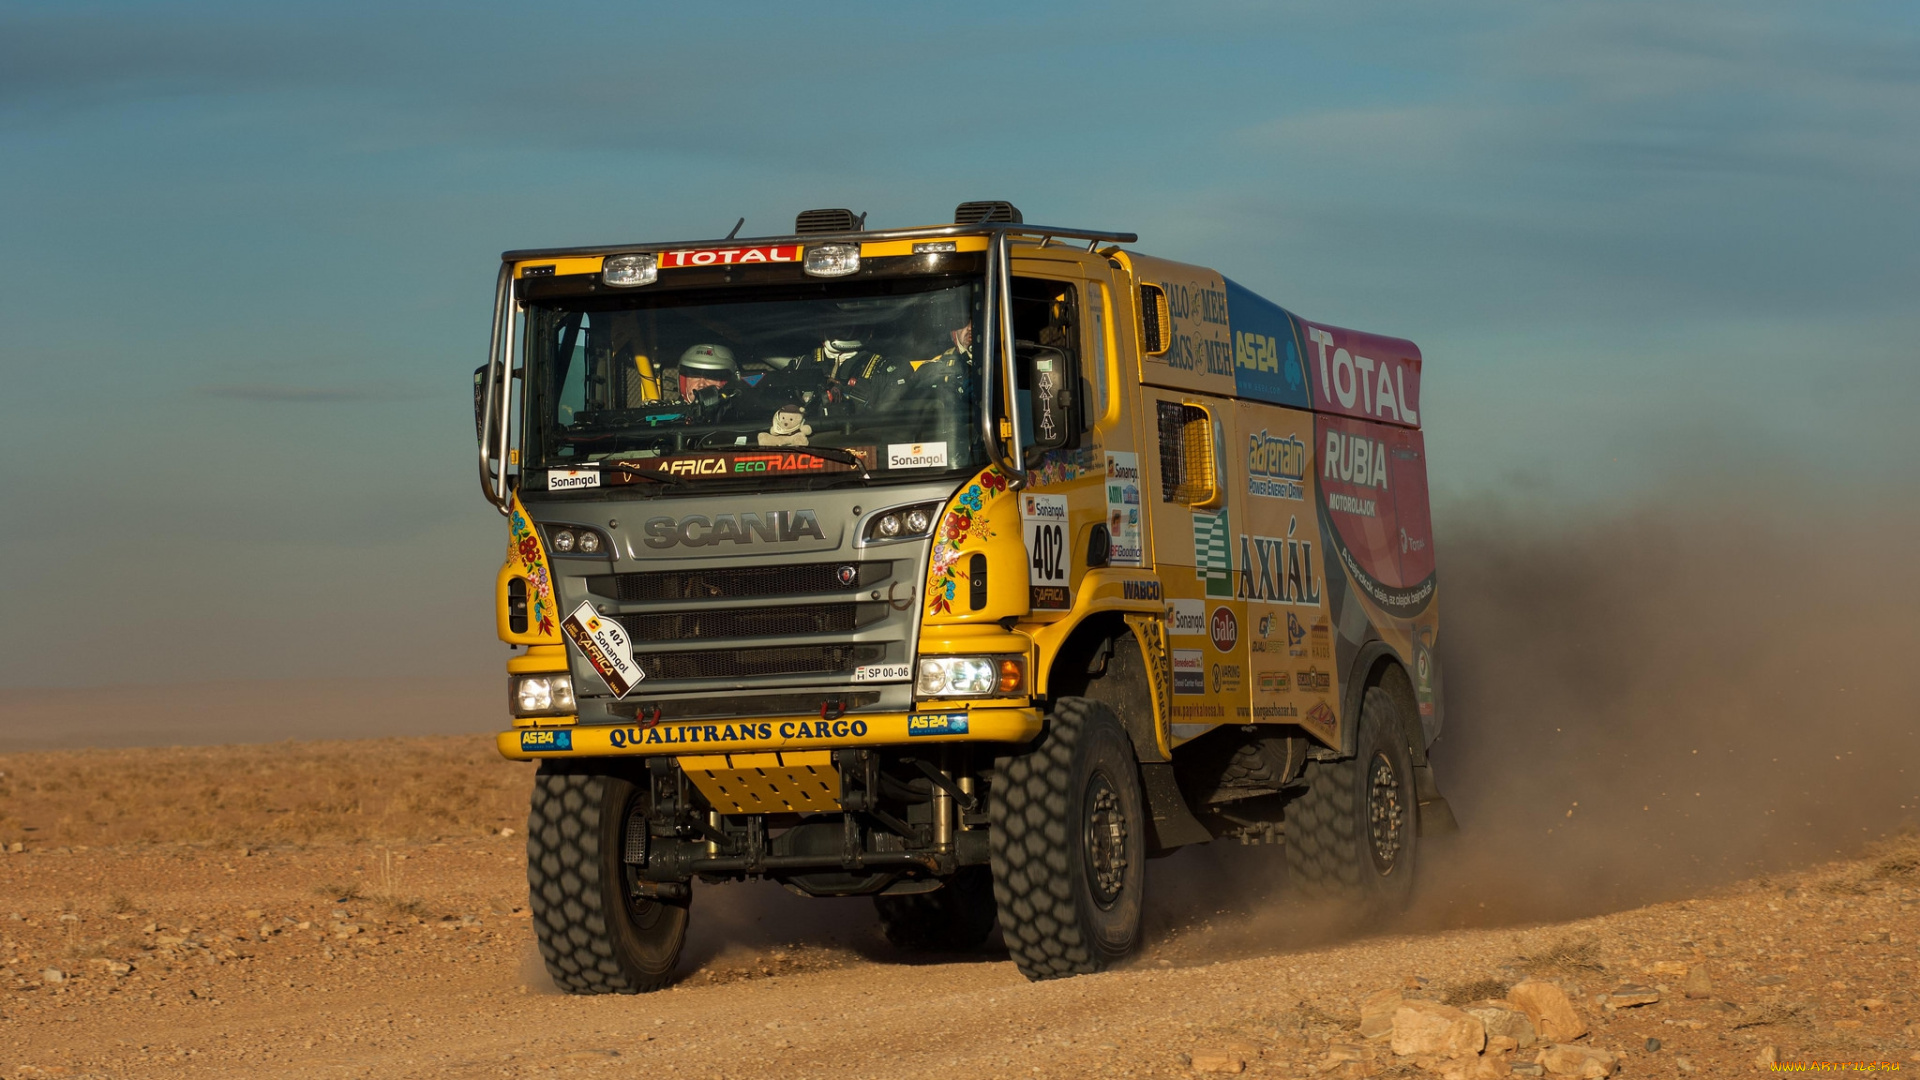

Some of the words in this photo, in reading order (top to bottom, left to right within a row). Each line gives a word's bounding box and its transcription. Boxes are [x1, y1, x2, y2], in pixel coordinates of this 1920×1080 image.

[669, 247, 792, 267] TOTAL
[1201, 281, 1227, 325] MÉH
[1204, 330, 1233, 377] MÉH
[1236, 330, 1279, 374] AS24
[1308, 326, 1418, 425] TOTAL
[658, 458, 727, 476] AFRICA
[891, 453, 944, 468] Sonangol
[1324, 428, 1388, 492] RUBIA
[550, 473, 597, 489] Sonangol
[1036, 502, 1065, 520] Sonangol
[1329, 492, 1376, 517] MOTOROLAJOK
[643, 508, 827, 549] SCANIA
[1033, 524, 1064, 581] 402
[1237, 515, 1321, 607] AXIÁL
[1123, 580, 1160, 600] WABCO
[1175, 610, 1205, 633] Sonangol
[1212, 614, 1236, 642] Gala
[609, 629, 624, 647] 402
[580, 639, 614, 677] AFRICA
[594, 630, 629, 675] Sonangol
[868, 667, 881, 679] SP
[883, 666, 909, 678] 00-06
[609, 722, 772, 748] QUALITRANS
[779, 720, 868, 739] CARGO
[910, 714, 948, 729] AS24
[522, 731, 554, 744] AS24
